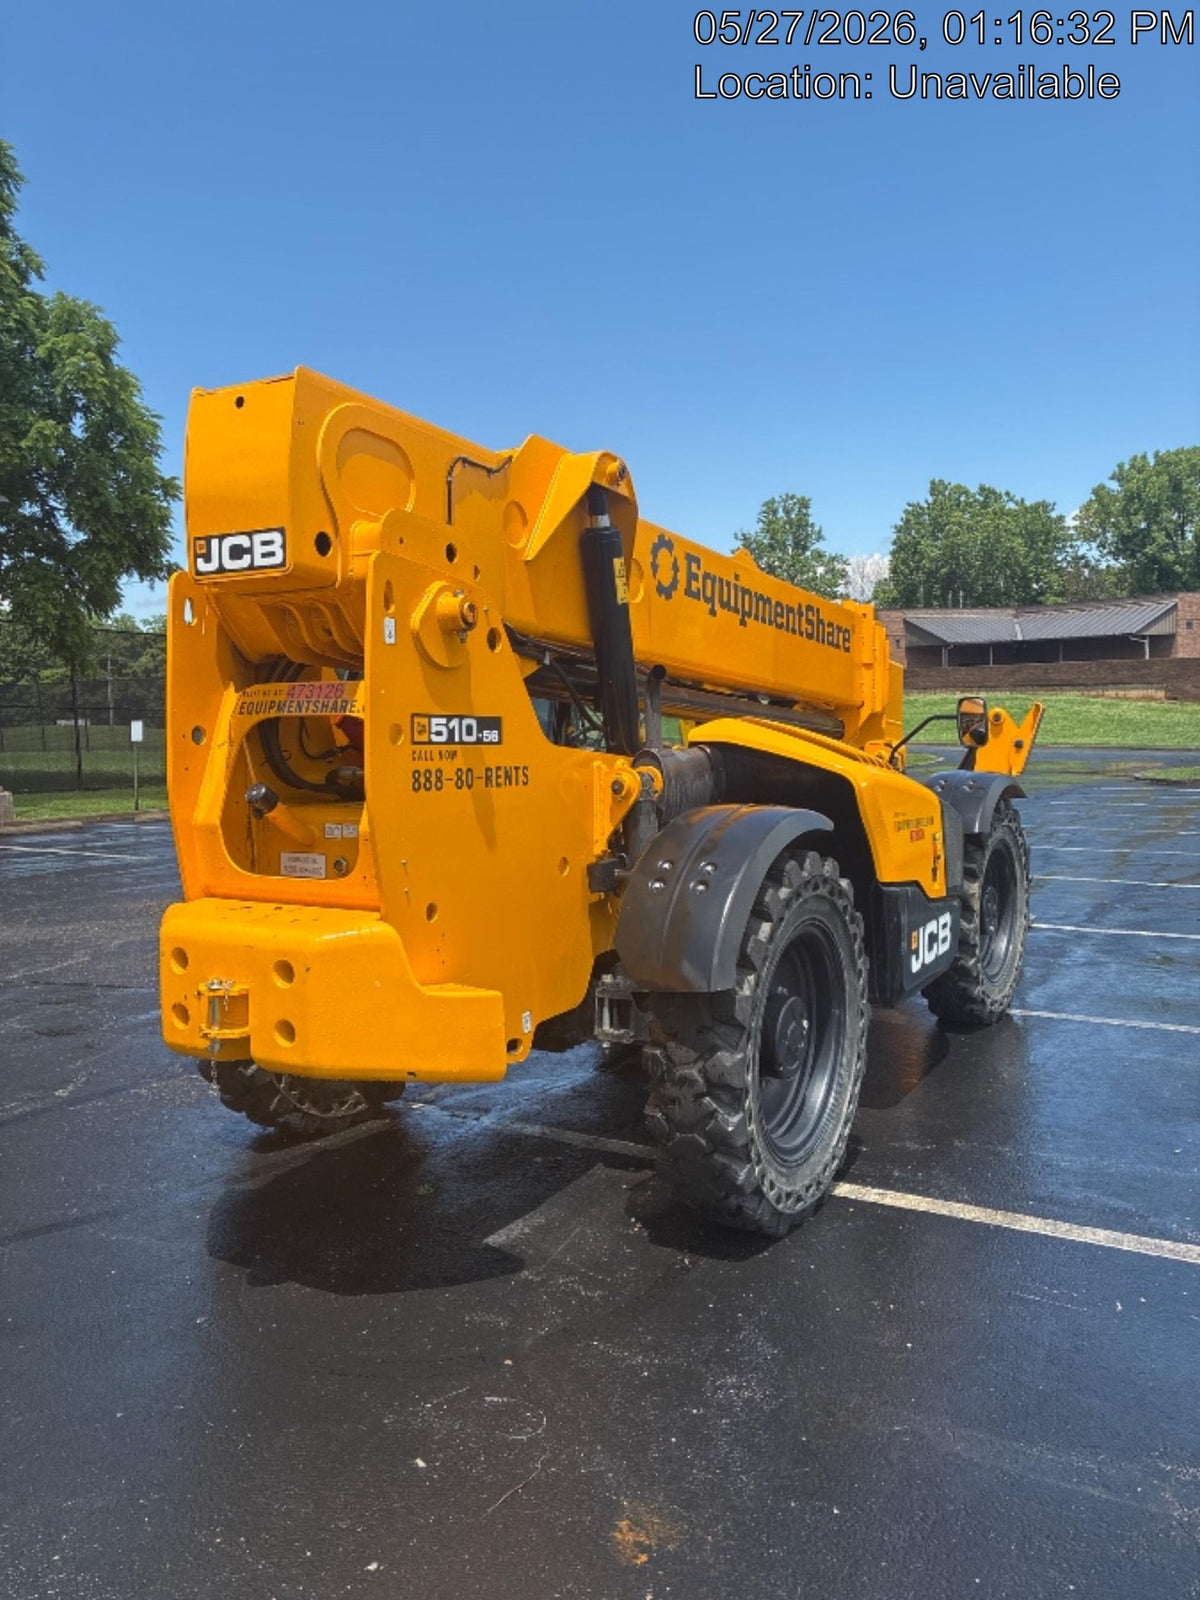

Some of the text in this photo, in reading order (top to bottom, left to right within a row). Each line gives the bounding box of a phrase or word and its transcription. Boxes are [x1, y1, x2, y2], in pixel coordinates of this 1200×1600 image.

[195, 531, 285, 573] JCB
[684, 552, 851, 653] EquipmentShare
[239, 699, 365, 715] EQUIPMENTSHARE.
[411, 749, 435, 762] CALL
[411, 765, 530, 793] 888-80-RENTS
[911, 911, 952, 974] JCB
